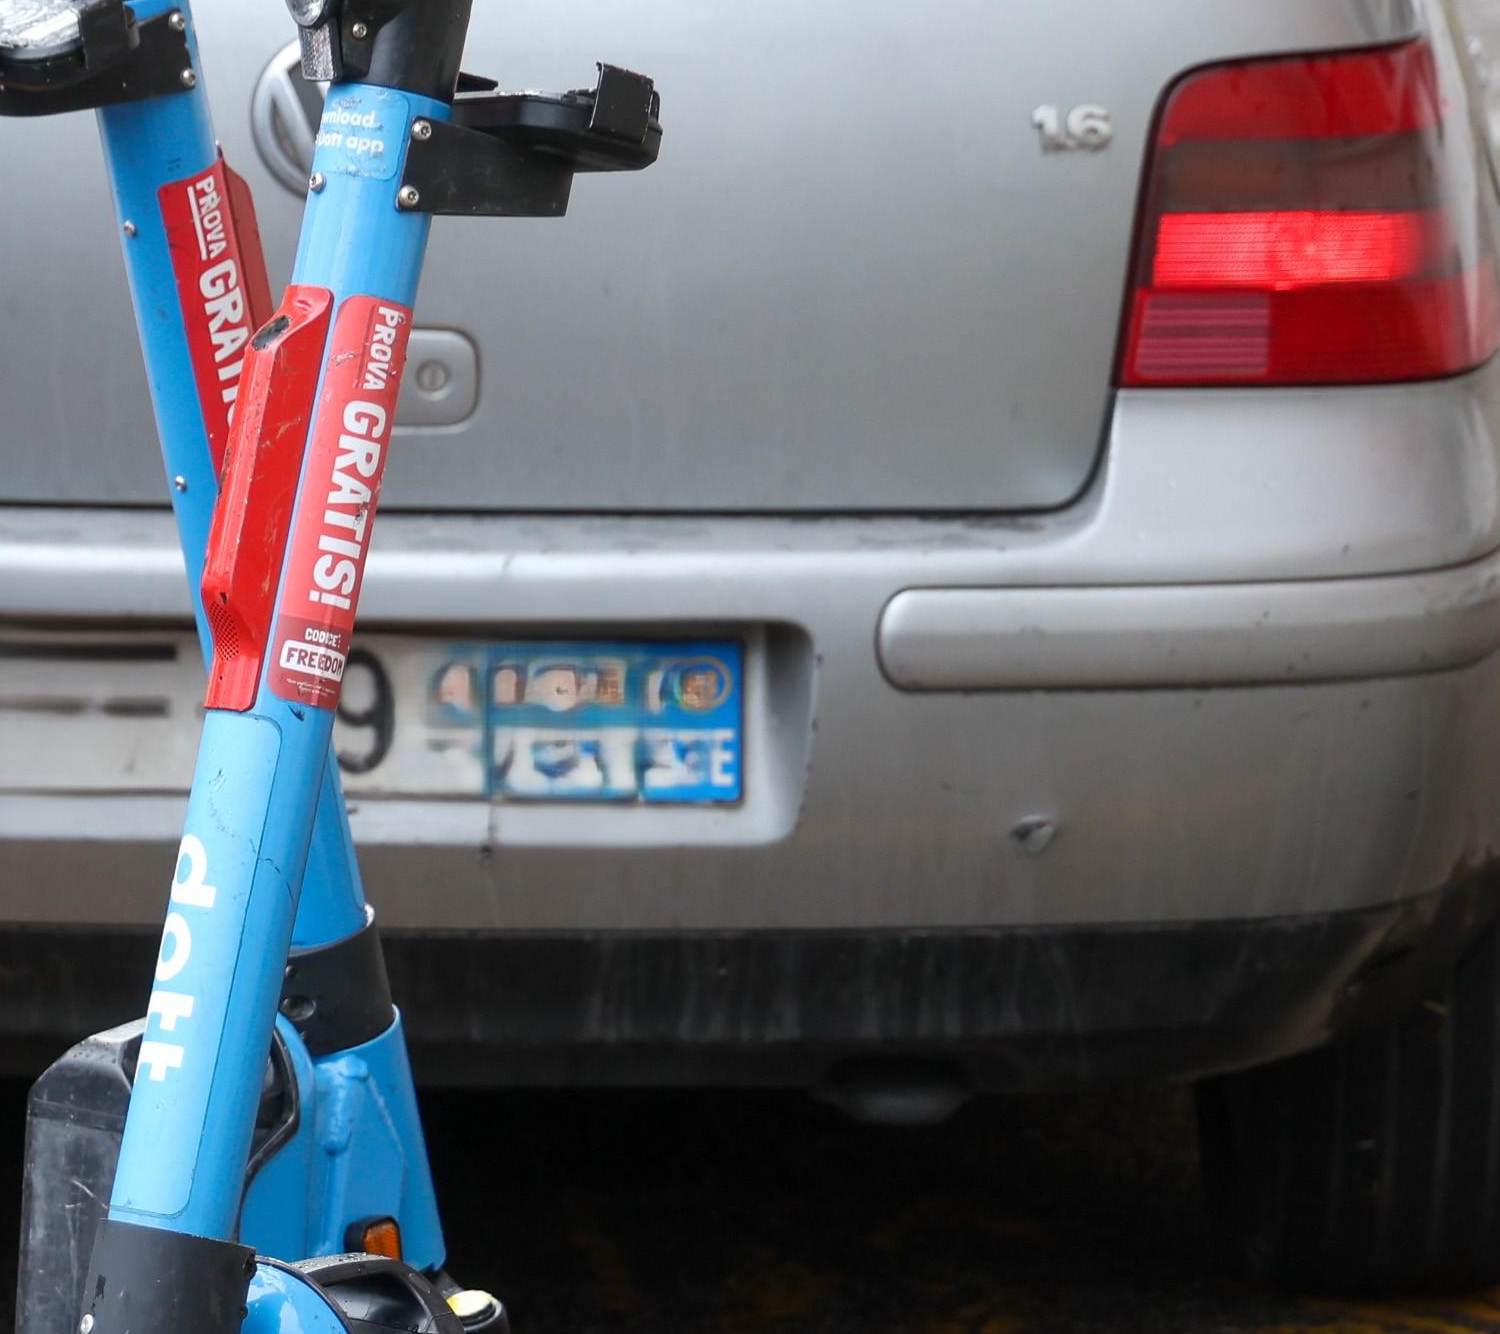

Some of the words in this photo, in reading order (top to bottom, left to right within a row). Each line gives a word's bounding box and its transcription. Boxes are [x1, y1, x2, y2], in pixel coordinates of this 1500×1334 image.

[346, 136, 384, 155] app
[195, 175, 227, 259] PROVA
[363, 306, 400, 390] PROVA
[309, 401, 387, 610] GRATIS!
[136, 834, 217, 1082] dott
